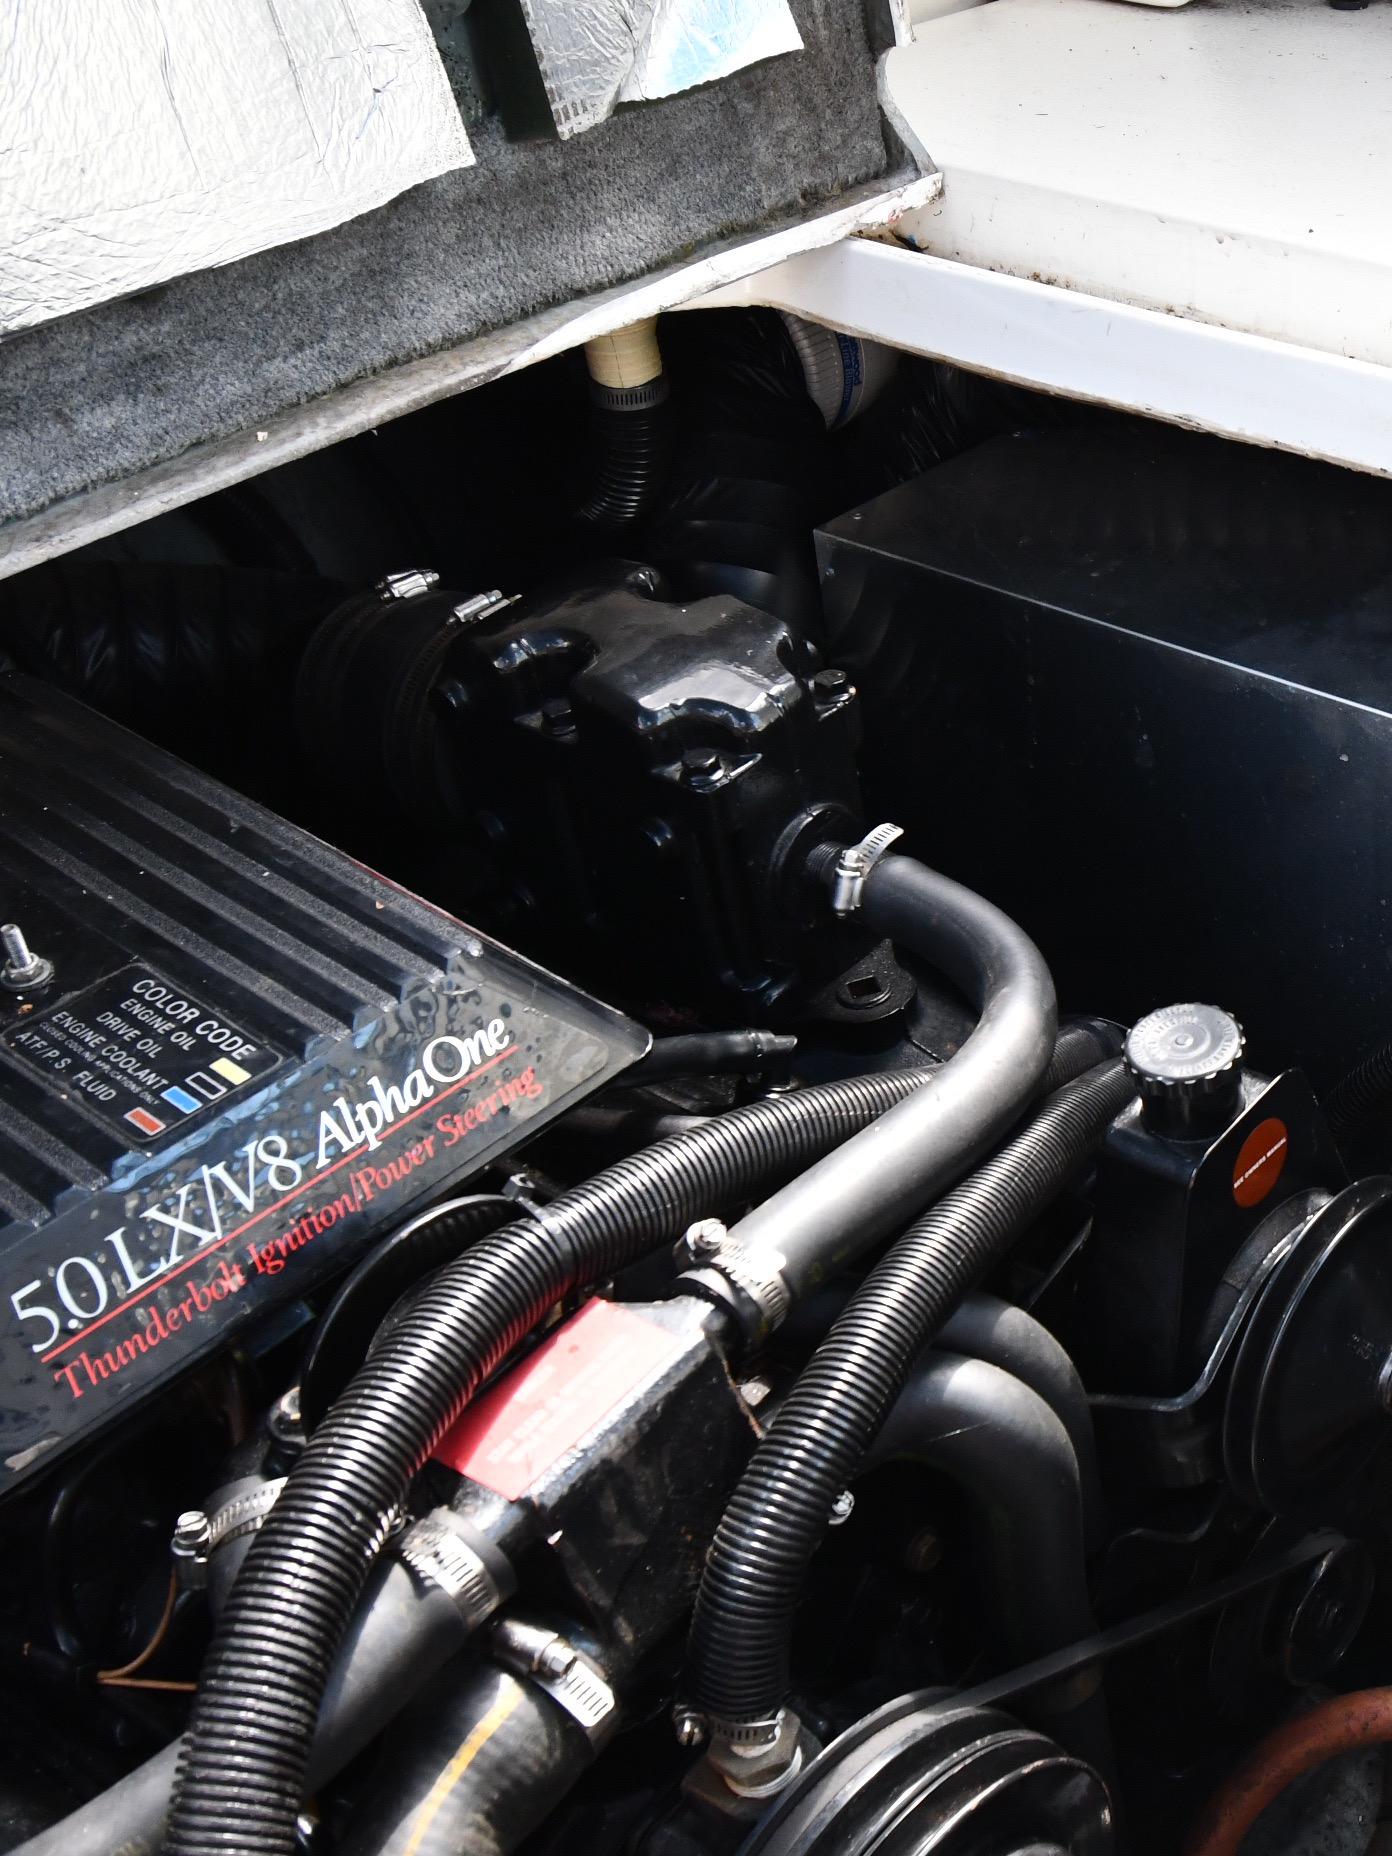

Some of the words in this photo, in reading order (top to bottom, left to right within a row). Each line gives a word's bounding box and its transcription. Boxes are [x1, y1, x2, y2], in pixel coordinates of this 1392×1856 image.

[52, 1011, 107, 1048] ENGINE
[101, 1045, 169, 1091] COOLANT
[96, 1011, 141, 1042] DRIVE
[136, 1038, 163, 1059] OIL
[120, 998, 173, 1035] ENGINE
[170, 1031, 198, 1051] OIL
[132, 979, 200, 1024] COLOR
[195, 1020, 257, 1061] CODE
[39, 1021, 68, 1042] CLOSED
[65, 1038, 94, 1062] COOLING
[95, 1060, 142, 1095] APPLICATIONS
[139, 1090, 159, 1105] ONLY
[73, 1070, 117, 1102] FLUID
[53, 1261, 247, 1400] Thunderbolt
[436, 1065, 544, 1148] Steering
